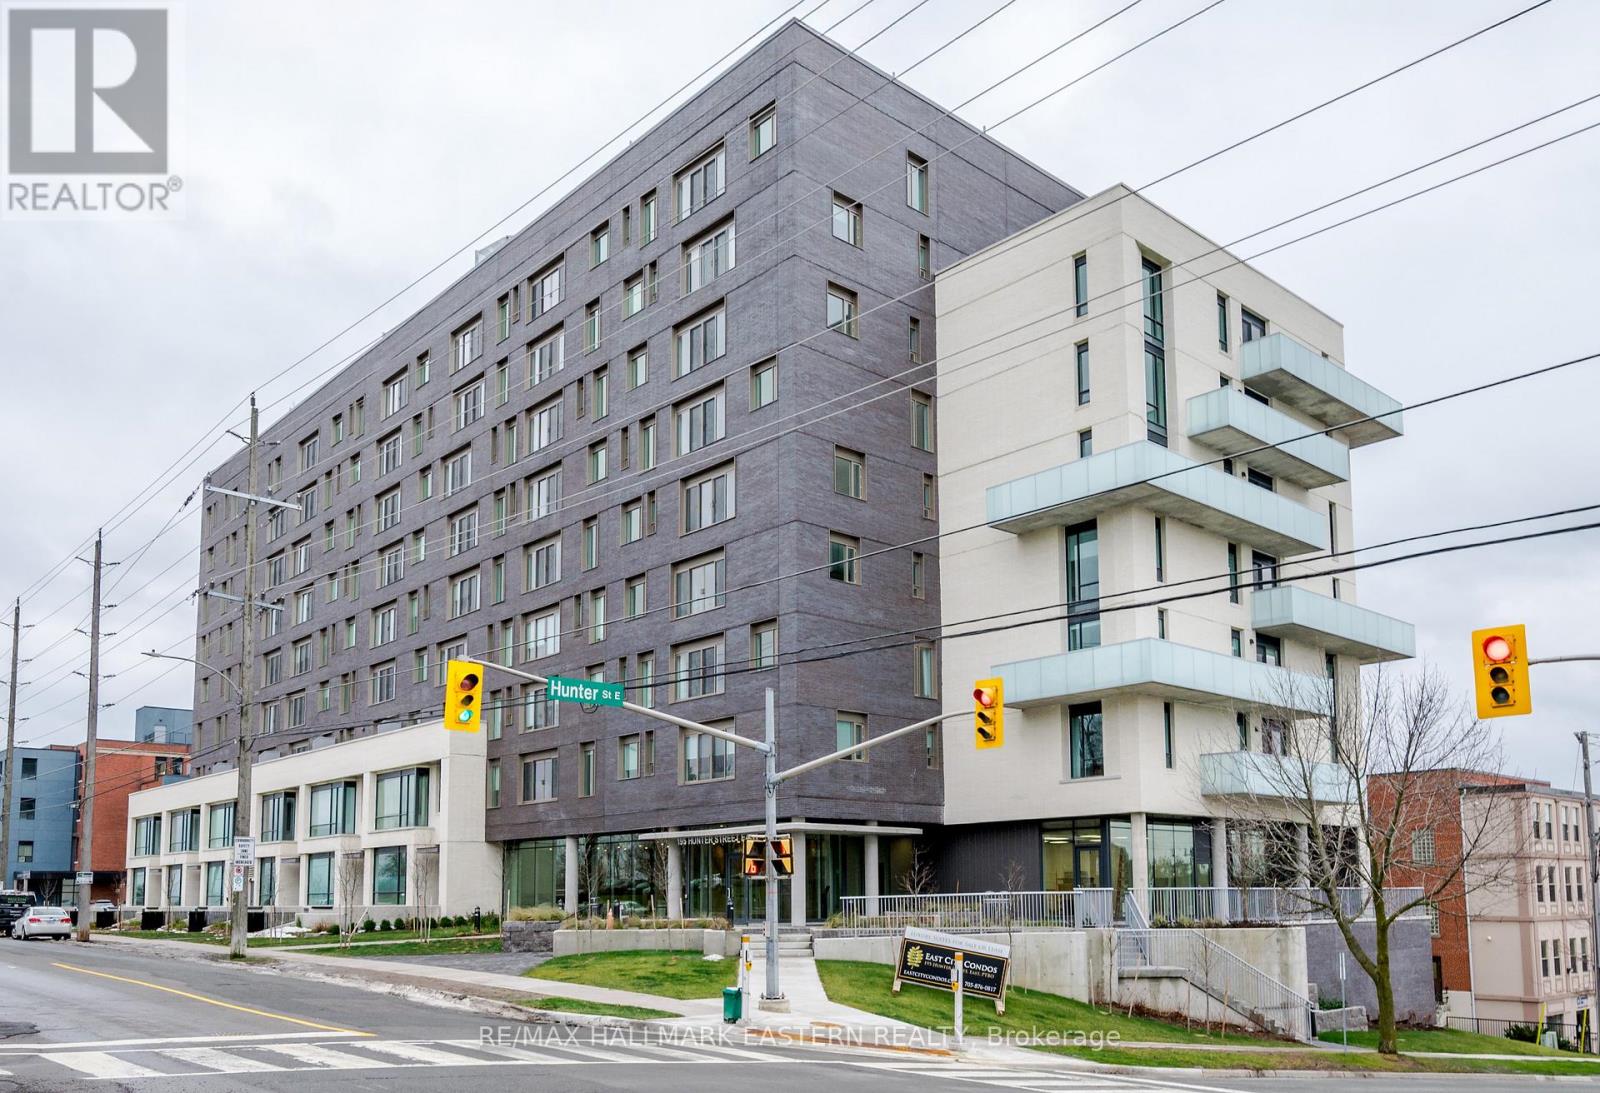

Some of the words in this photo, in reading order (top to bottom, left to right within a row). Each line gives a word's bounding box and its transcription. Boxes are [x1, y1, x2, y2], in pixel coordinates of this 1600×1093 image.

[550, 679, 599, 701] Hunter
[602, 690, 612, 699] St
[614, 691, 621, 700] E
[687, 835, 713, 845] HUNTER
[964, 961, 998, 973] CONDOS
